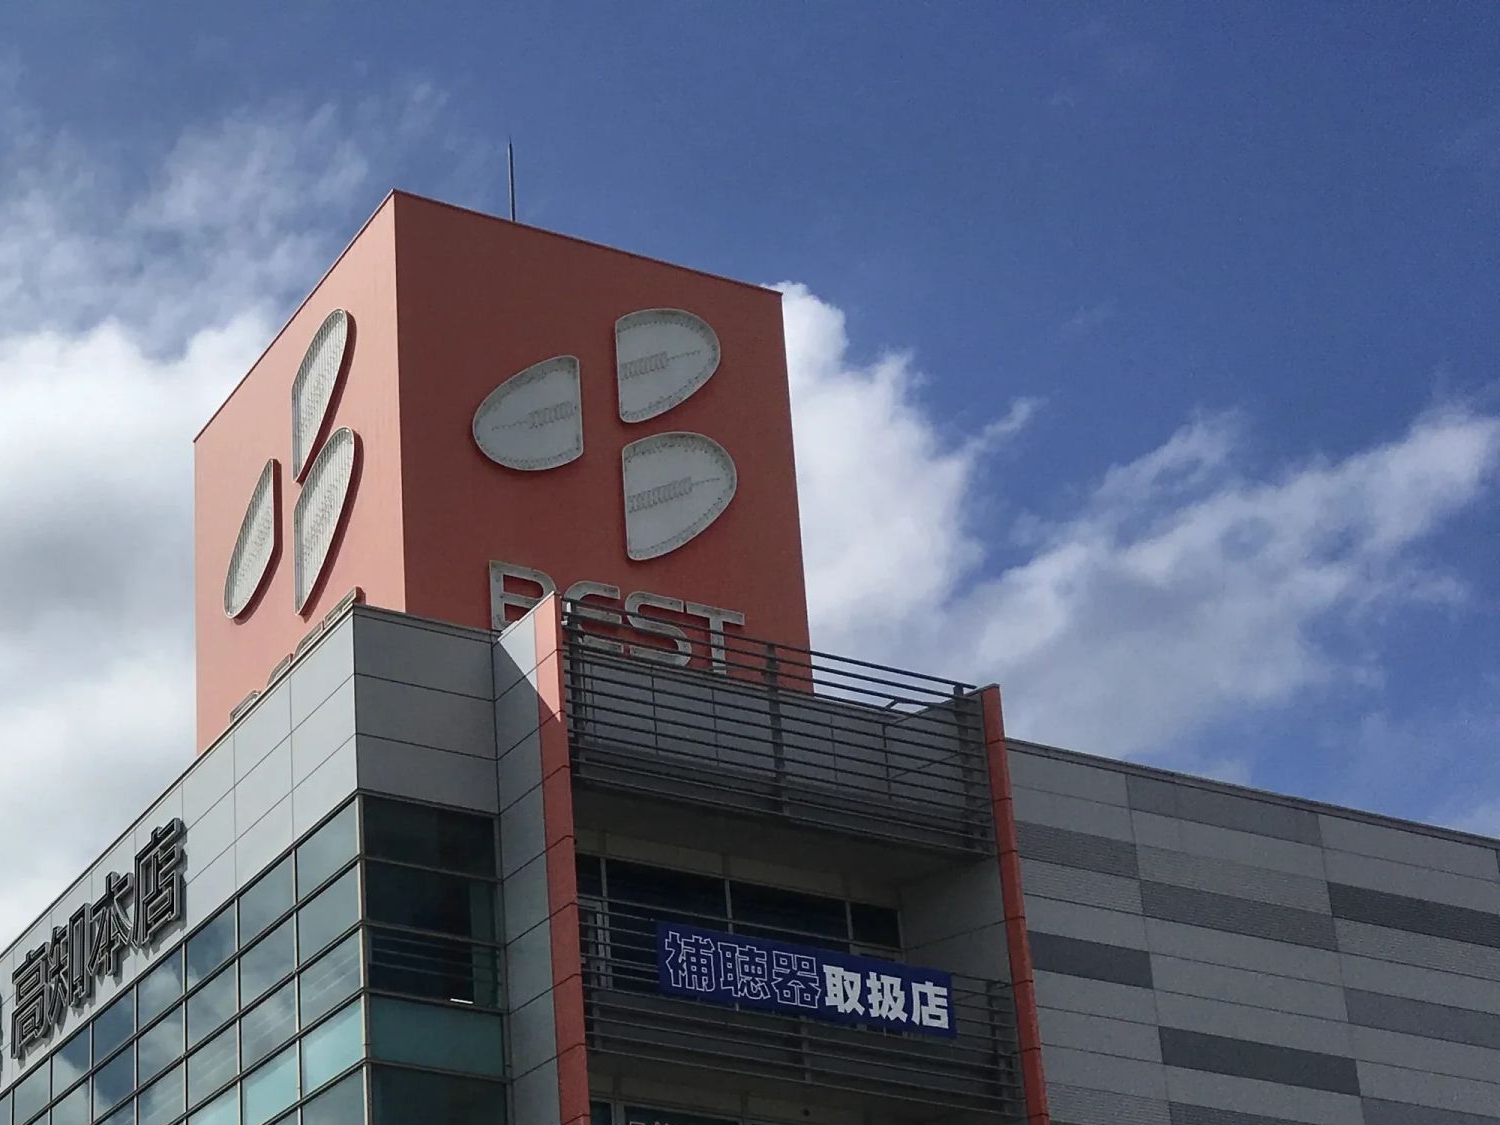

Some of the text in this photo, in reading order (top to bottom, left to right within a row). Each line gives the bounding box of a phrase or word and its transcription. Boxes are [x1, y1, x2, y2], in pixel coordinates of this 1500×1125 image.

[489, 559, 746, 676] BEST
[11, 816, 187, 1060] 高知本店
[664, 930, 950, 1030] 補聴器取扱店
